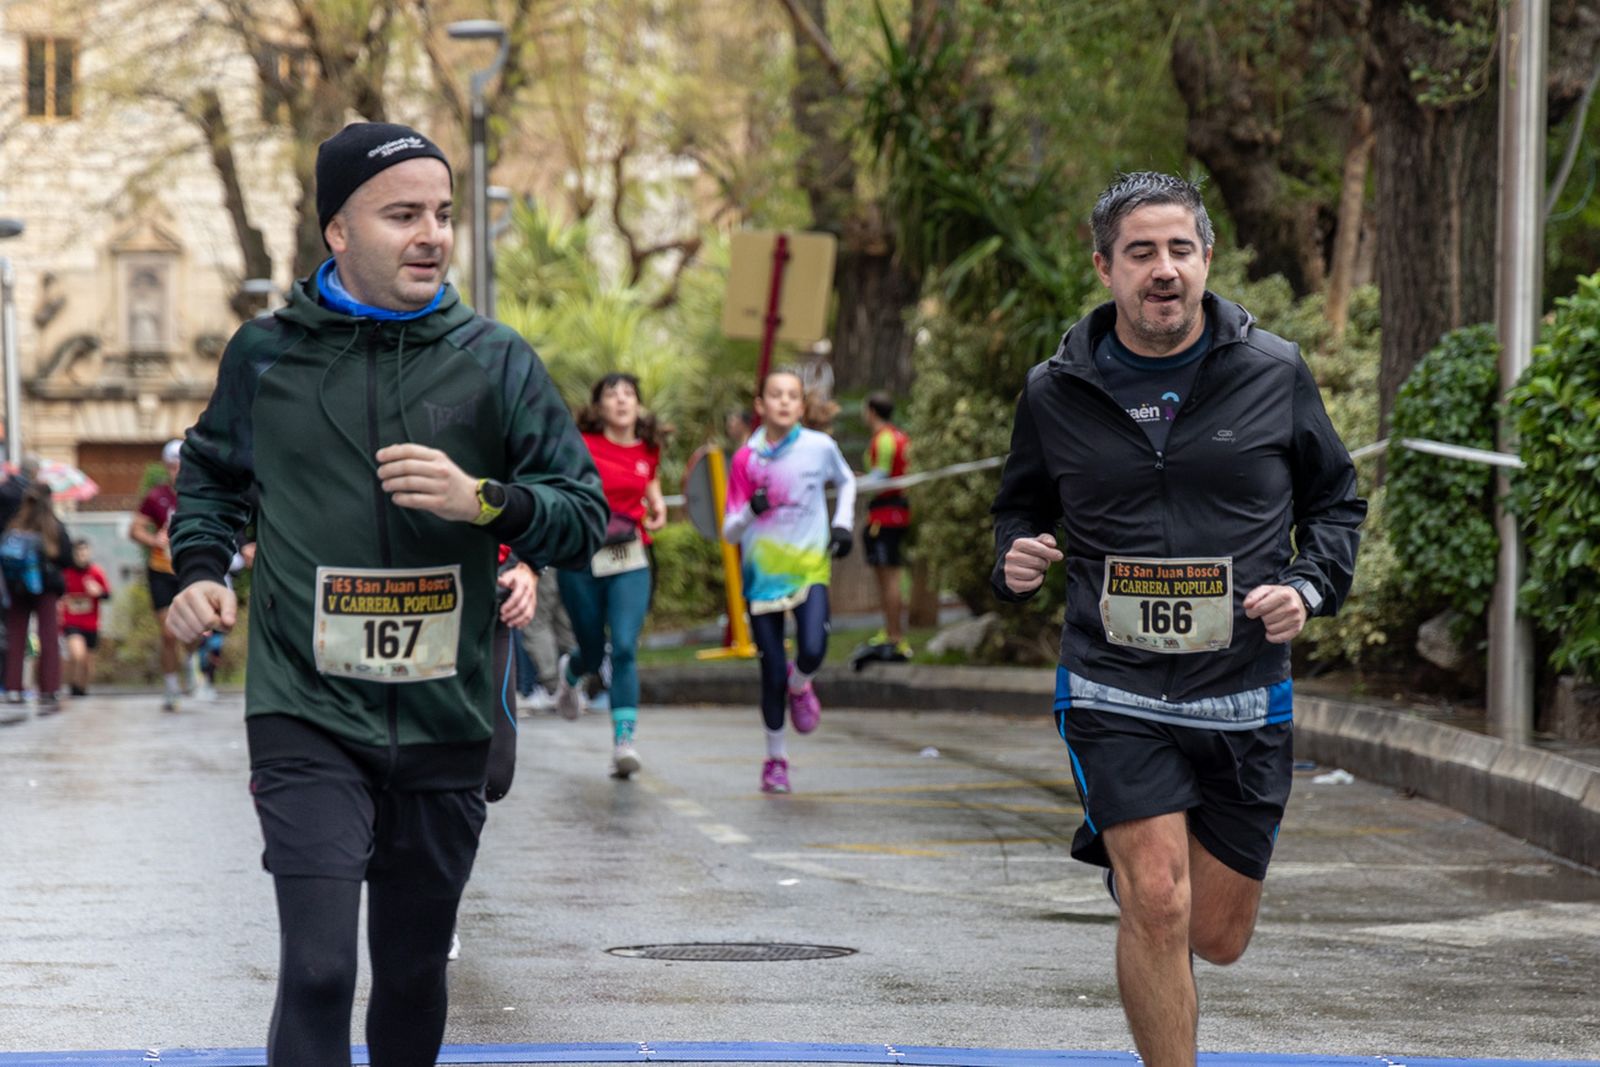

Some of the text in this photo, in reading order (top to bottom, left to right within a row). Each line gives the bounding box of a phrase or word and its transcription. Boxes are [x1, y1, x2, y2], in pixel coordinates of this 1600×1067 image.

[1115, 564, 1220, 578] IES San Juan Bosco
[332, 577, 352, 593] IES
[355, 577, 381, 593] San
[384, 577, 416, 593] Juan
[1112, 579, 1223, 595] V CARRERA POPULAR
[328, 593, 454, 612] V CARRERA POPULAR
[1140, 600, 1192, 635] 166
[363, 619, 424, 660] 167
